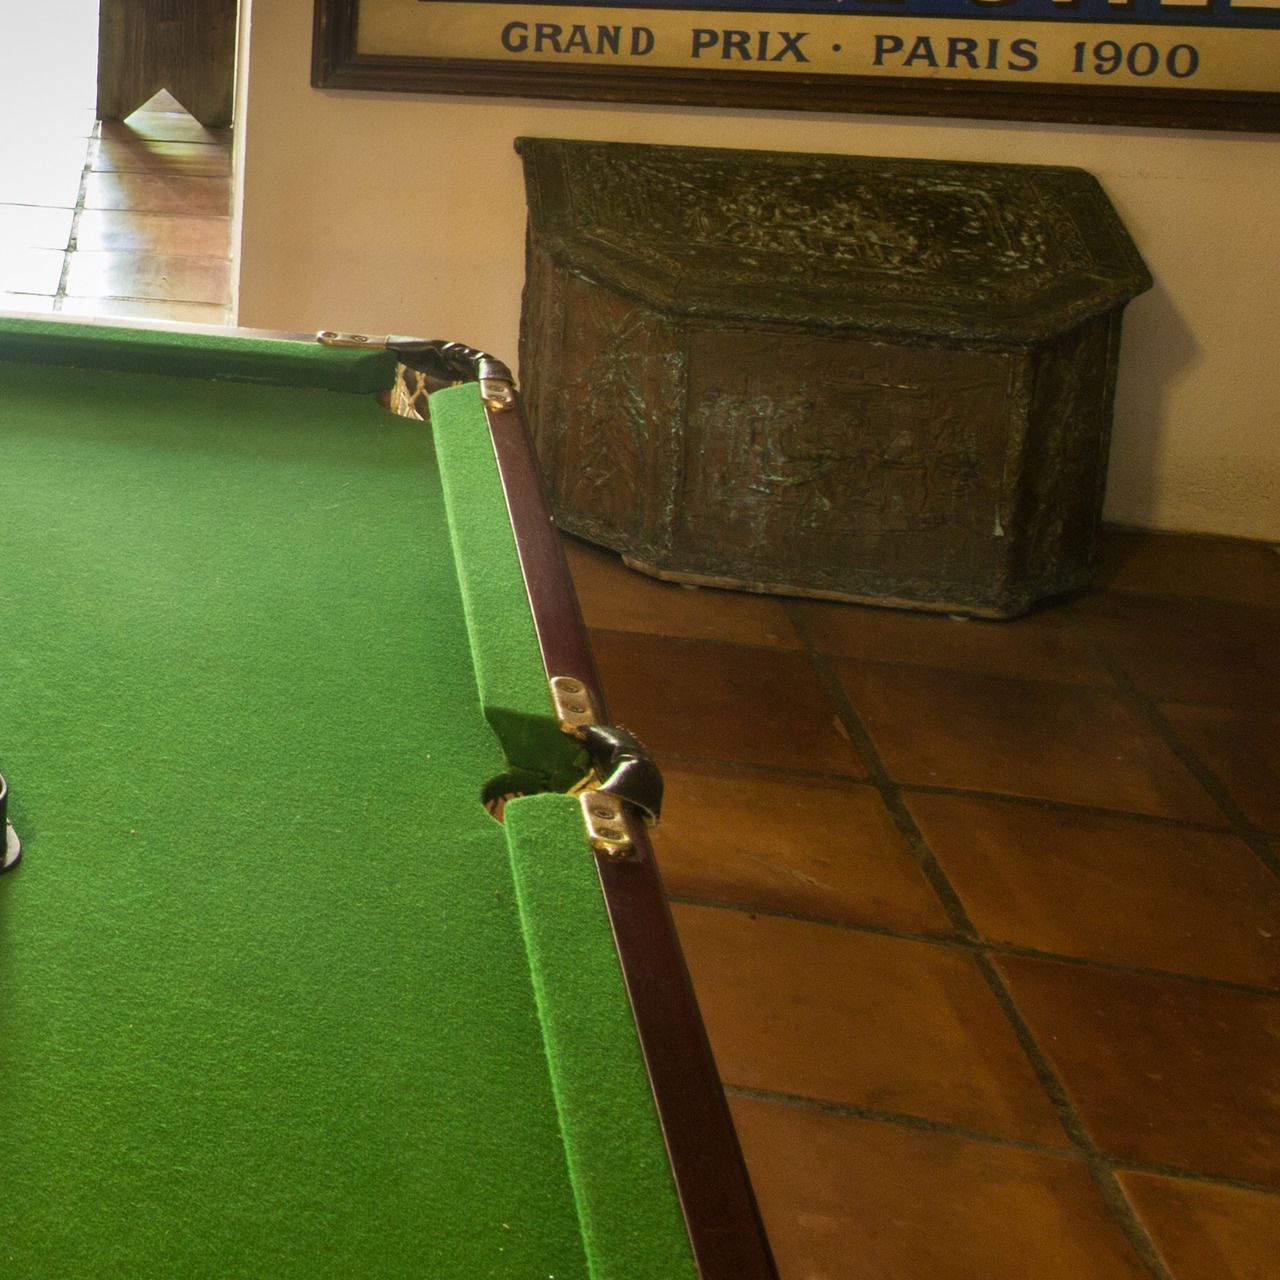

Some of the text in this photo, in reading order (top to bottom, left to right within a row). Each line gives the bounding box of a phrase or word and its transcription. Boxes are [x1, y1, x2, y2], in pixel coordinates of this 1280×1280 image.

[499, 20, 1200, 79] GRAND PRIX PARIS 1900
